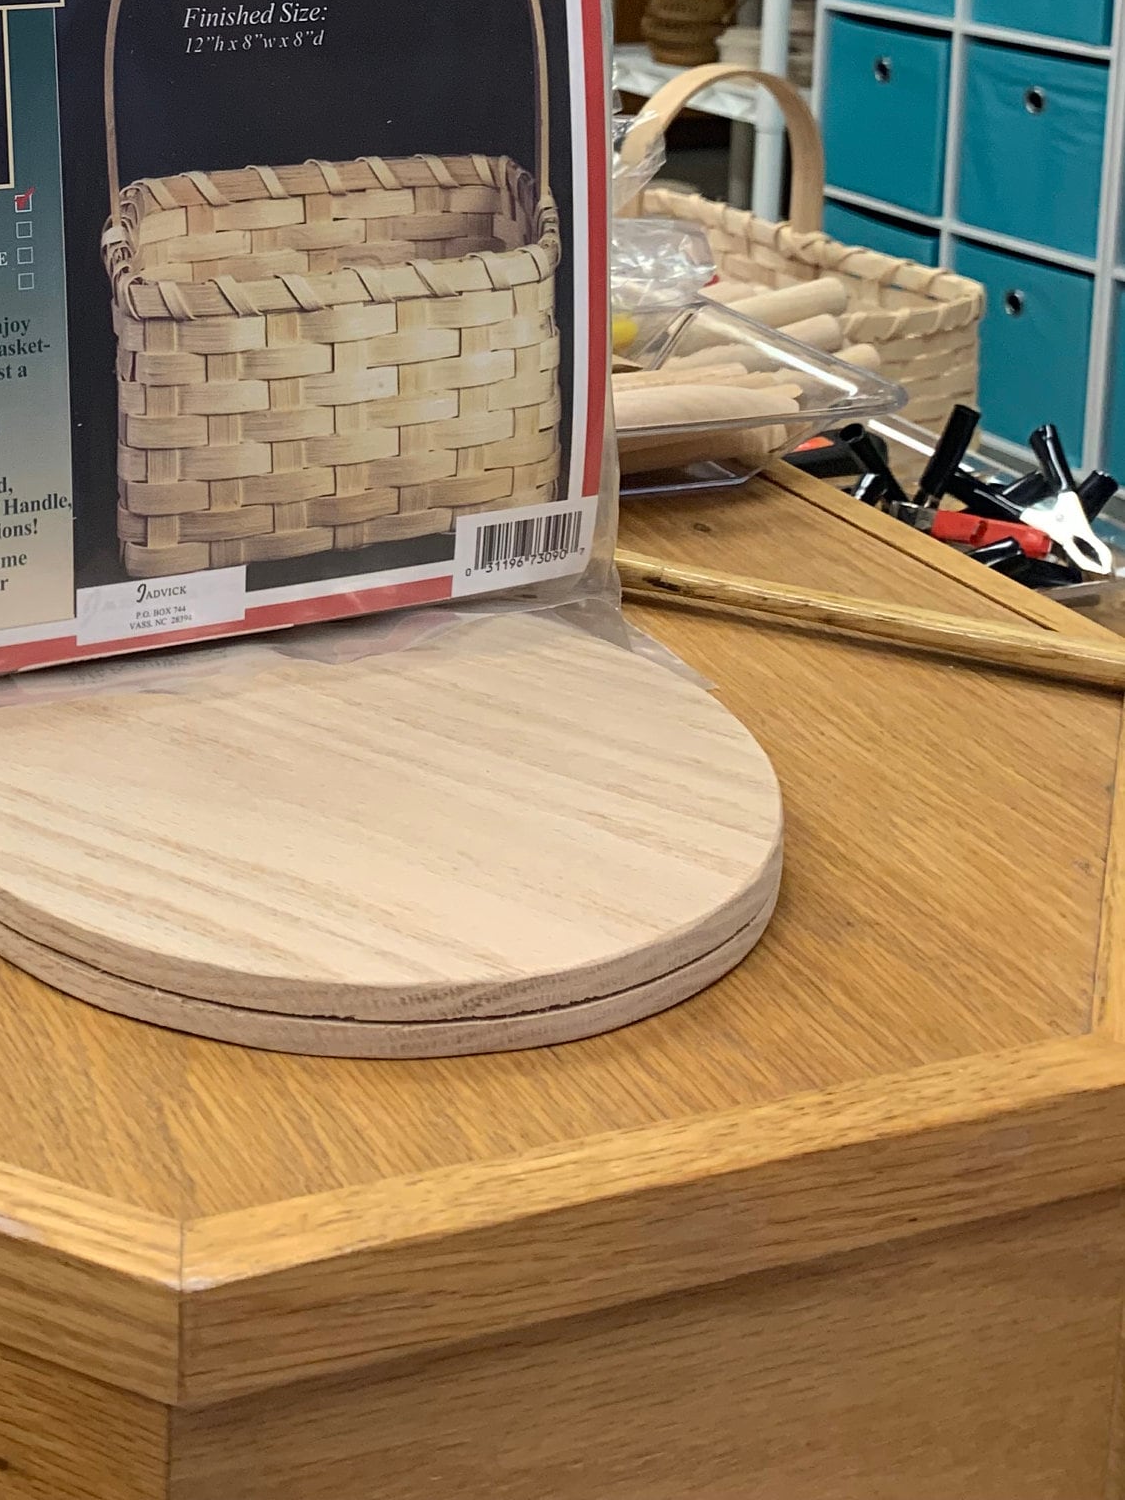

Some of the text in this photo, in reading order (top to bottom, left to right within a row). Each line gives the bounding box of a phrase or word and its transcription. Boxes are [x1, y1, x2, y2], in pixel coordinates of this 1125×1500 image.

[182, 2, 328, 29] Finished Size:
[227, 37, 238, 51] x
[278, 36, 289, 49] x
[17, 365, 28, 378] a
[4, 493, 73, 516] Handle,
[465, 547, 585, 577] 0 31196 73090 7
[153, 607, 172, 617] BOX
[155, 618, 169, 627] NC
